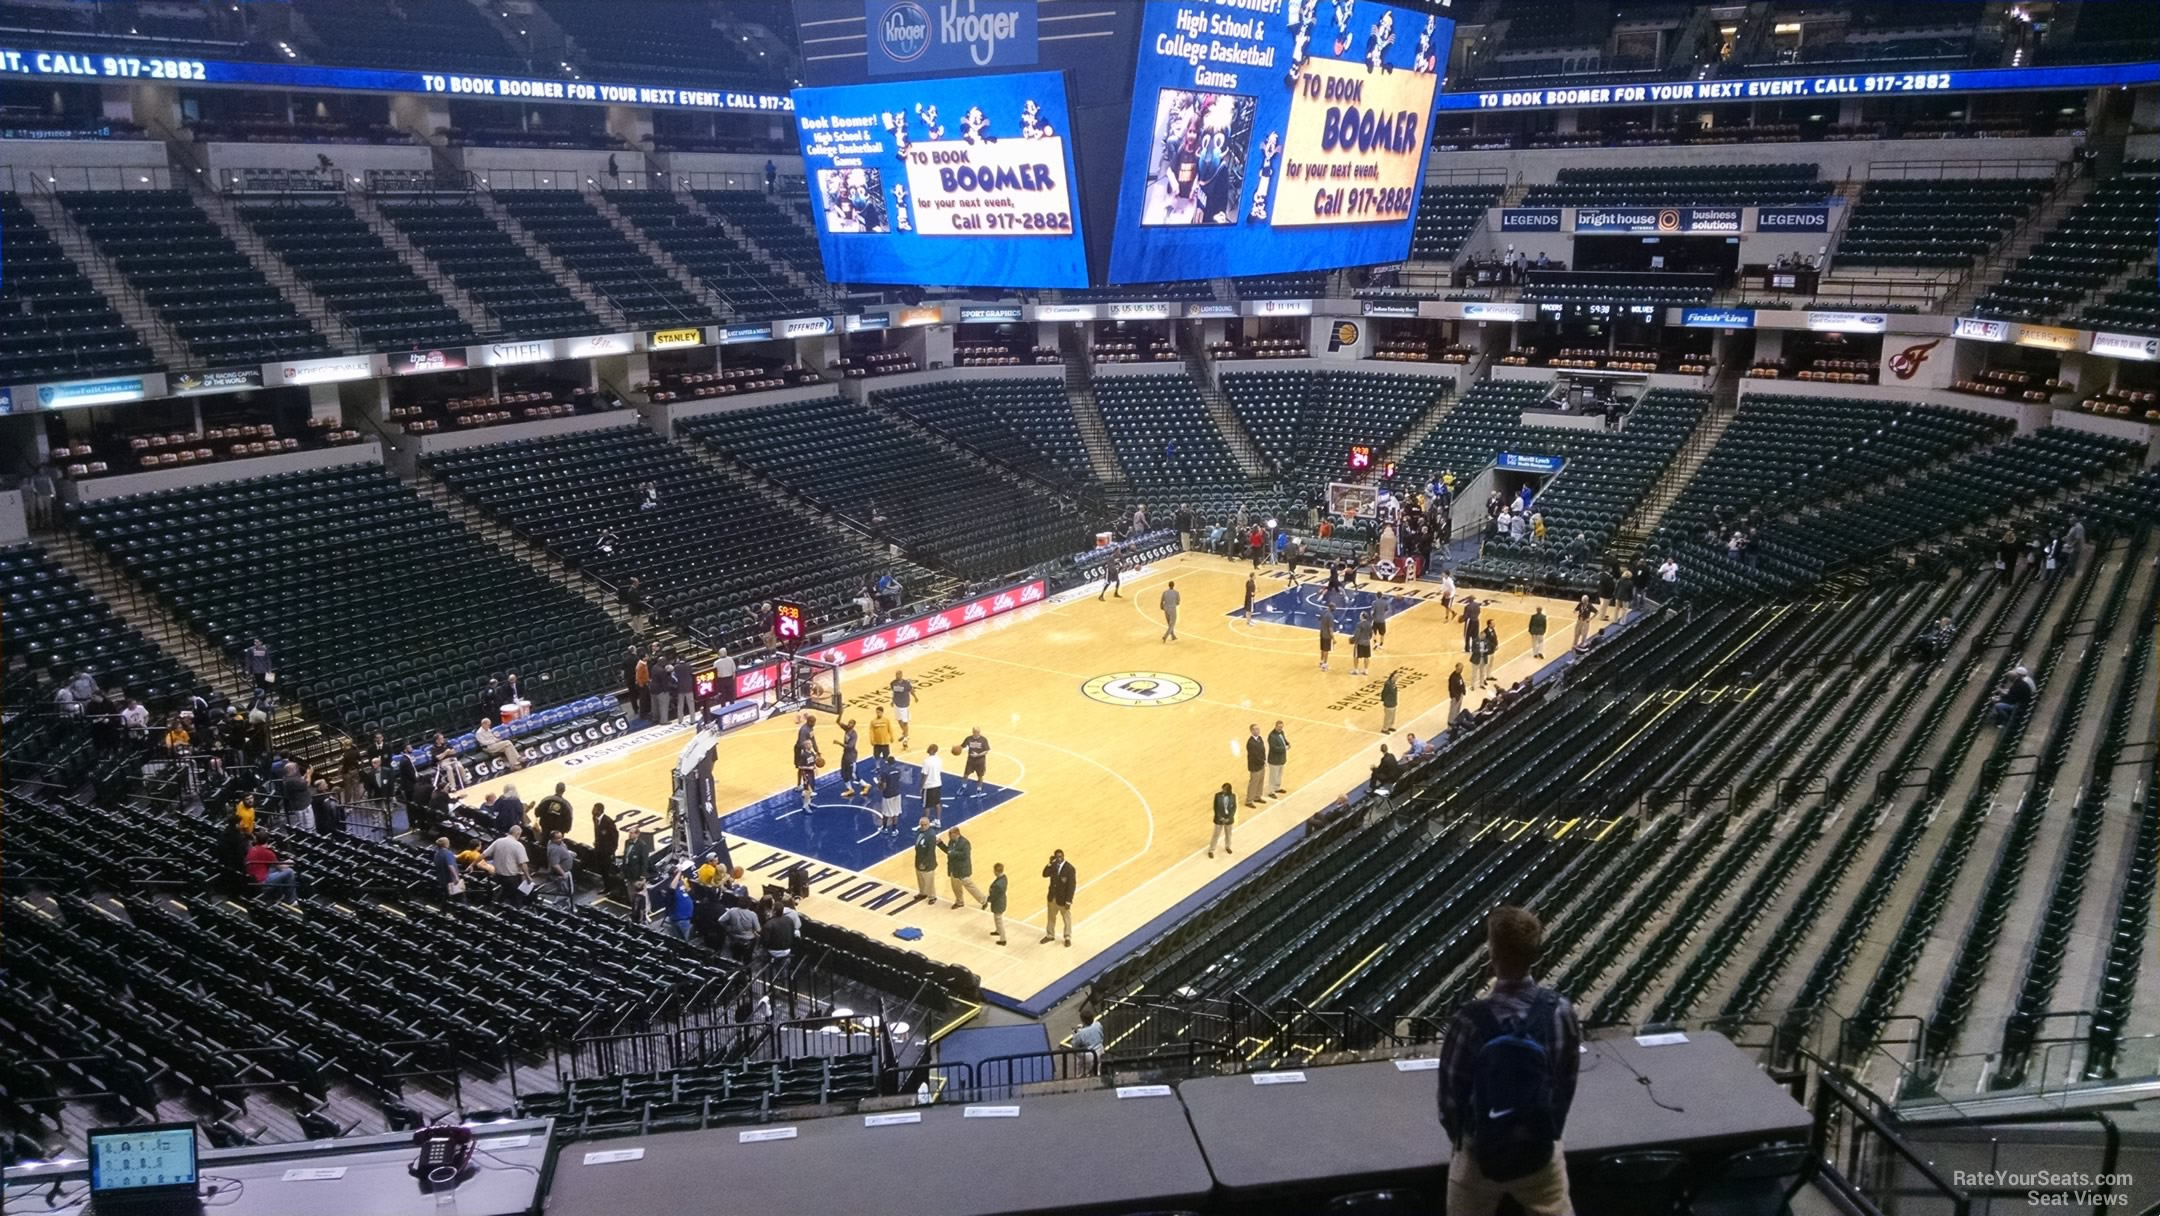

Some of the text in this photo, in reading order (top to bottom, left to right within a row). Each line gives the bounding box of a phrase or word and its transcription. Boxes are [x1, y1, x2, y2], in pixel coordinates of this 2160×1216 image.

[886, 12, 926, 53] Kroger
[941, 0, 1019, 65] Kroger
[1176, 9, 1264, 41] High School &
[1156, 33, 1274, 67] College Basketball
[37, 54, 206, 80] CALL 917-2882
[1194, 65, 1237, 89] Games
[423, 75, 757, 109] TO BOOK BOOMER FOR YOUR NEXT EVENT, CALL
[1303, 73, 1364, 101] TO BOOK
[1479, 74, 1951, 108] TO BOOK BOOMER FOR YOUR NEXT EVENT, CALL 917-2882
[801, 113, 878, 130] Book Boomer!
[813, 130, 871, 144] High School &
[1322, 106, 1419, 155] BOOMER
[806, 141, 884, 158] College Basketball
[910, 149, 970, 165] TO BOOK
[833, 155, 862, 167] Games
[939, 163, 1055, 193] BOOMER
[1286, 159, 1379, 181] for your next event,
[918, 197, 1014, 211] for your next event,
[1314, 187, 1412, 217] Call 917-2882
[951, 212, 1070, 230] Call 917-2882
[1504, 215, 1559, 226] LEGENDS
[1578, 213, 1656, 226] bright house
[1692, 210, 1737, 220] business
[1759, 214, 1825, 226] LEGENDS
[1691, 219, 1738, 230] solutions
[961, 309, 1022, 318] SPORT GRAPHICS
[1487, 306, 1521, 315] Kinetico
[1688, 313, 1748, 322] Finish Line
[788, 322, 824, 332] DEFENDER
[1963, 320, 2000, 337] FOX 59
[658, 332, 697, 344] STANLEY
[2096, 337, 2142, 350] DRIVEN TO WIN
[216, 372, 237, 380] RACING
[1353, 453, 1368, 466] 24
[1518, 455, 1534, 463] Merrill
[1083, 570, 1091, 580] G
[1090, 568, 1098, 577] G
[1133, 555, 1140, 563] G
[1140, 552, 1147, 561] G
[1146, 550, 1153, 559] G
[1153, 548, 1160, 557] G
[1159, 546, 1166, 555] G
[1166, 544, 1173, 553] G
[777, 604, 799, 619] 59:38
[779, 617, 800, 636] 24
[741, 670, 772, 693] Lilly
[862, 635, 888, 654] Lilly
[896, 624, 921, 643] Lilly
[928, 613, 952, 632] Lilly
[964, 603, 987, 621] Lilly
[992, 594, 1015, 611] Lilly
[1020, 585, 1042, 601] Lilly
[920, 665, 957, 679] LIFE
[1327, 679, 1384, 711] BANKERS
[732, 707, 758, 723] Pacers
[474, 762, 490, 776] G
[492, 757, 506, 770] G
[524, 747, 538, 760] G
[540, 742, 554, 755] G
[555, 737, 569, 749] G
[571, 731, 584, 744] G
[586, 727, 599, 740] G
[600, 722, 613, 735] G
[615, 717, 628, 730] G
